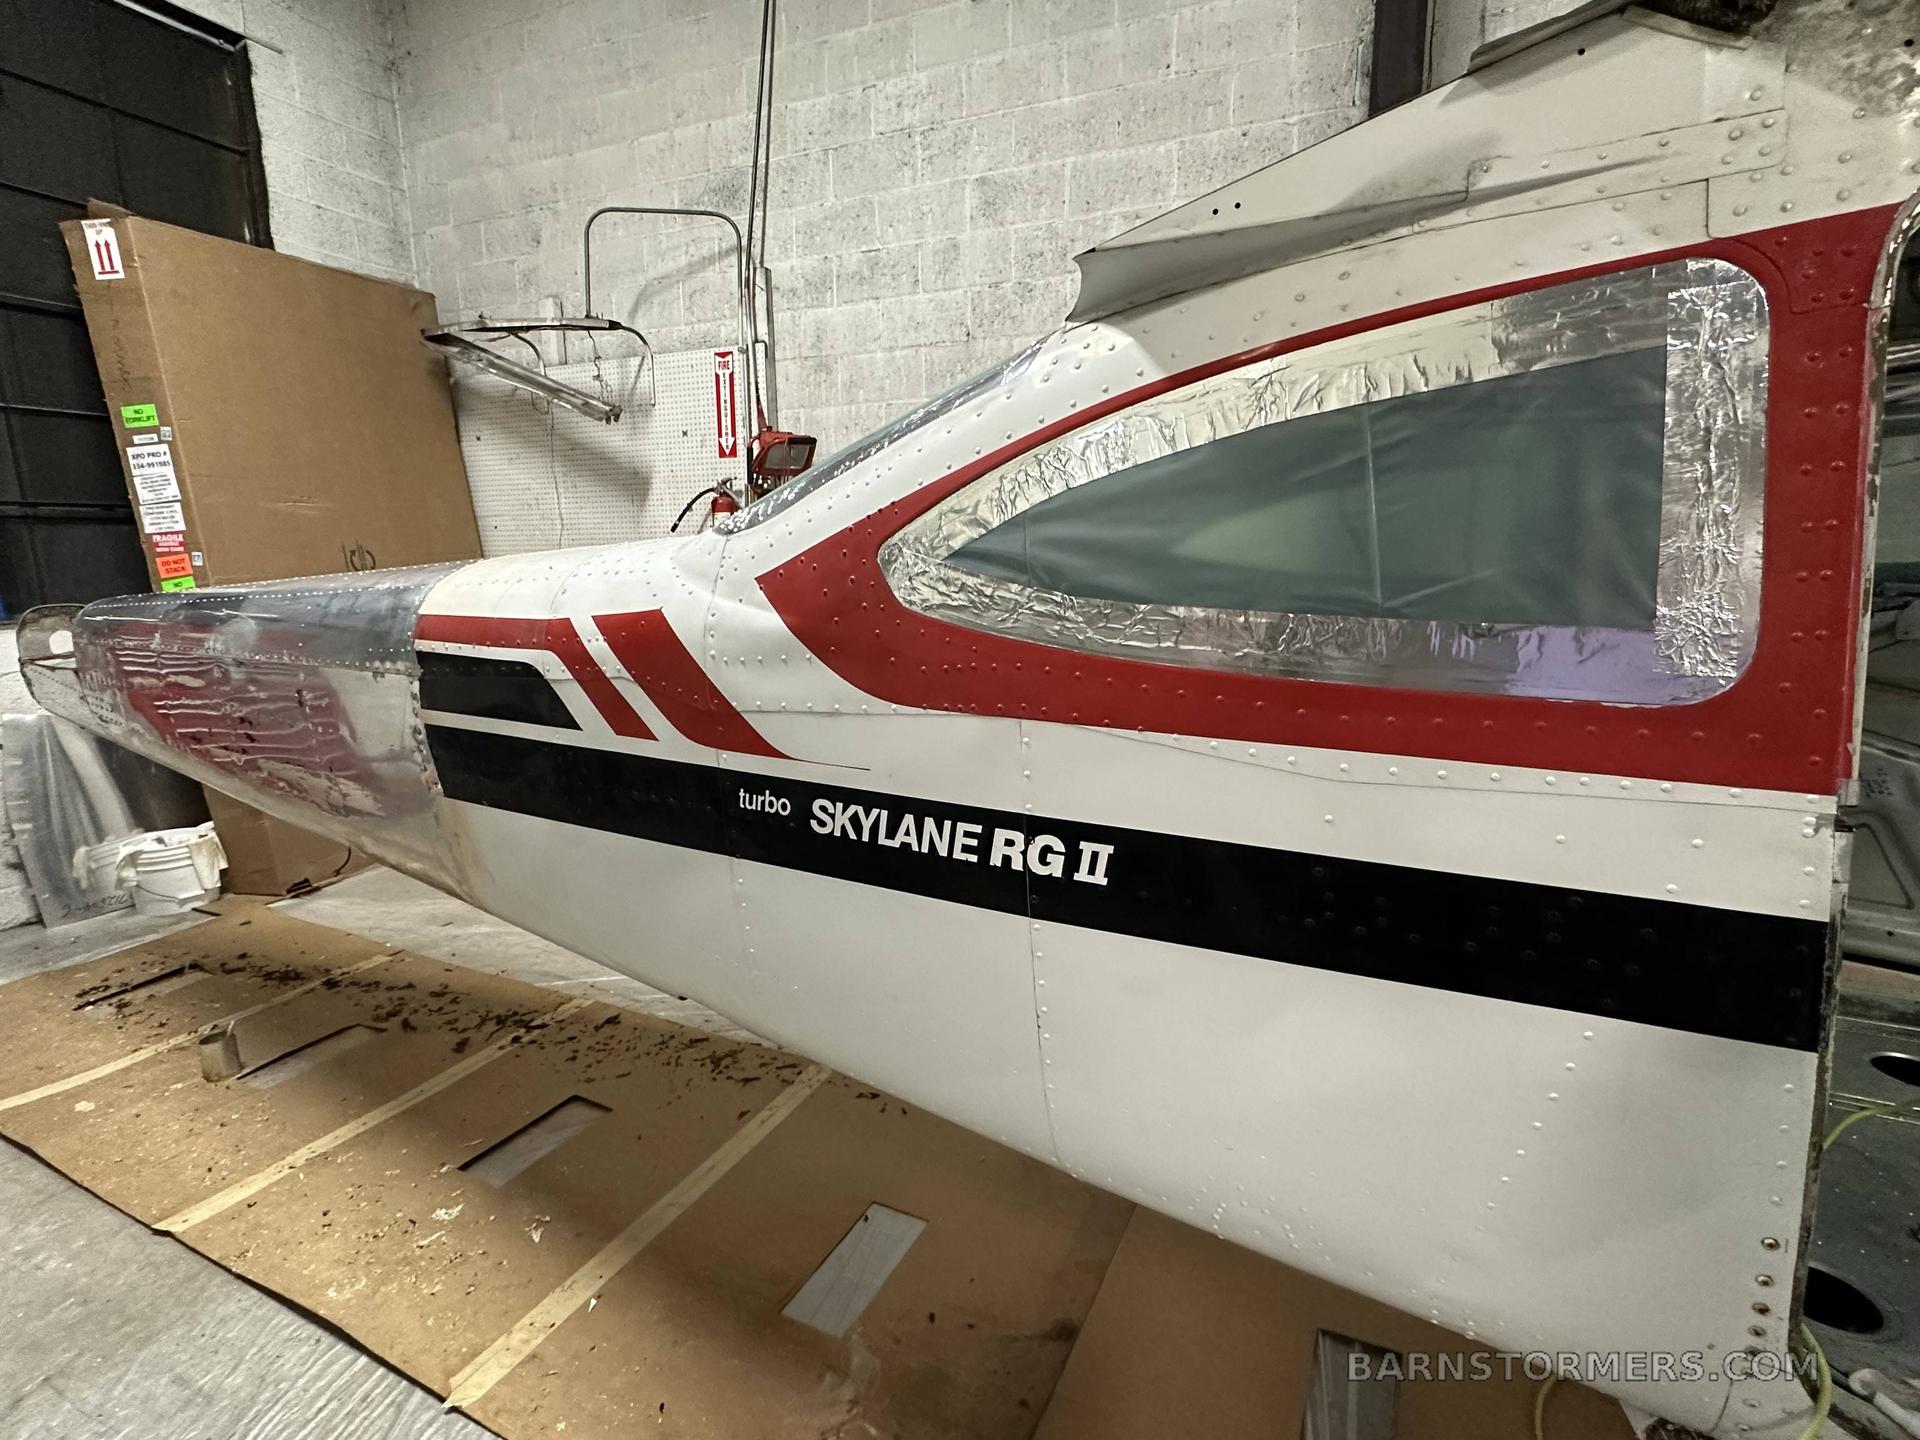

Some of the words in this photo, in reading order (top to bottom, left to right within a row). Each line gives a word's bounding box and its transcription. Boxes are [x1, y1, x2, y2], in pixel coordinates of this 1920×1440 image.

[718, 361, 730, 370] FIRE
[125, 415, 155, 424] FORKLIFT
[152, 533, 184, 543] FRAGILE
[165, 566, 186, 574] STACK
[738, 788, 791, 816] turbo
[809, 798, 982, 862] SKYLANE
[989, 828, 1066, 878] RG
[1073, 841, 1114, 886] II
